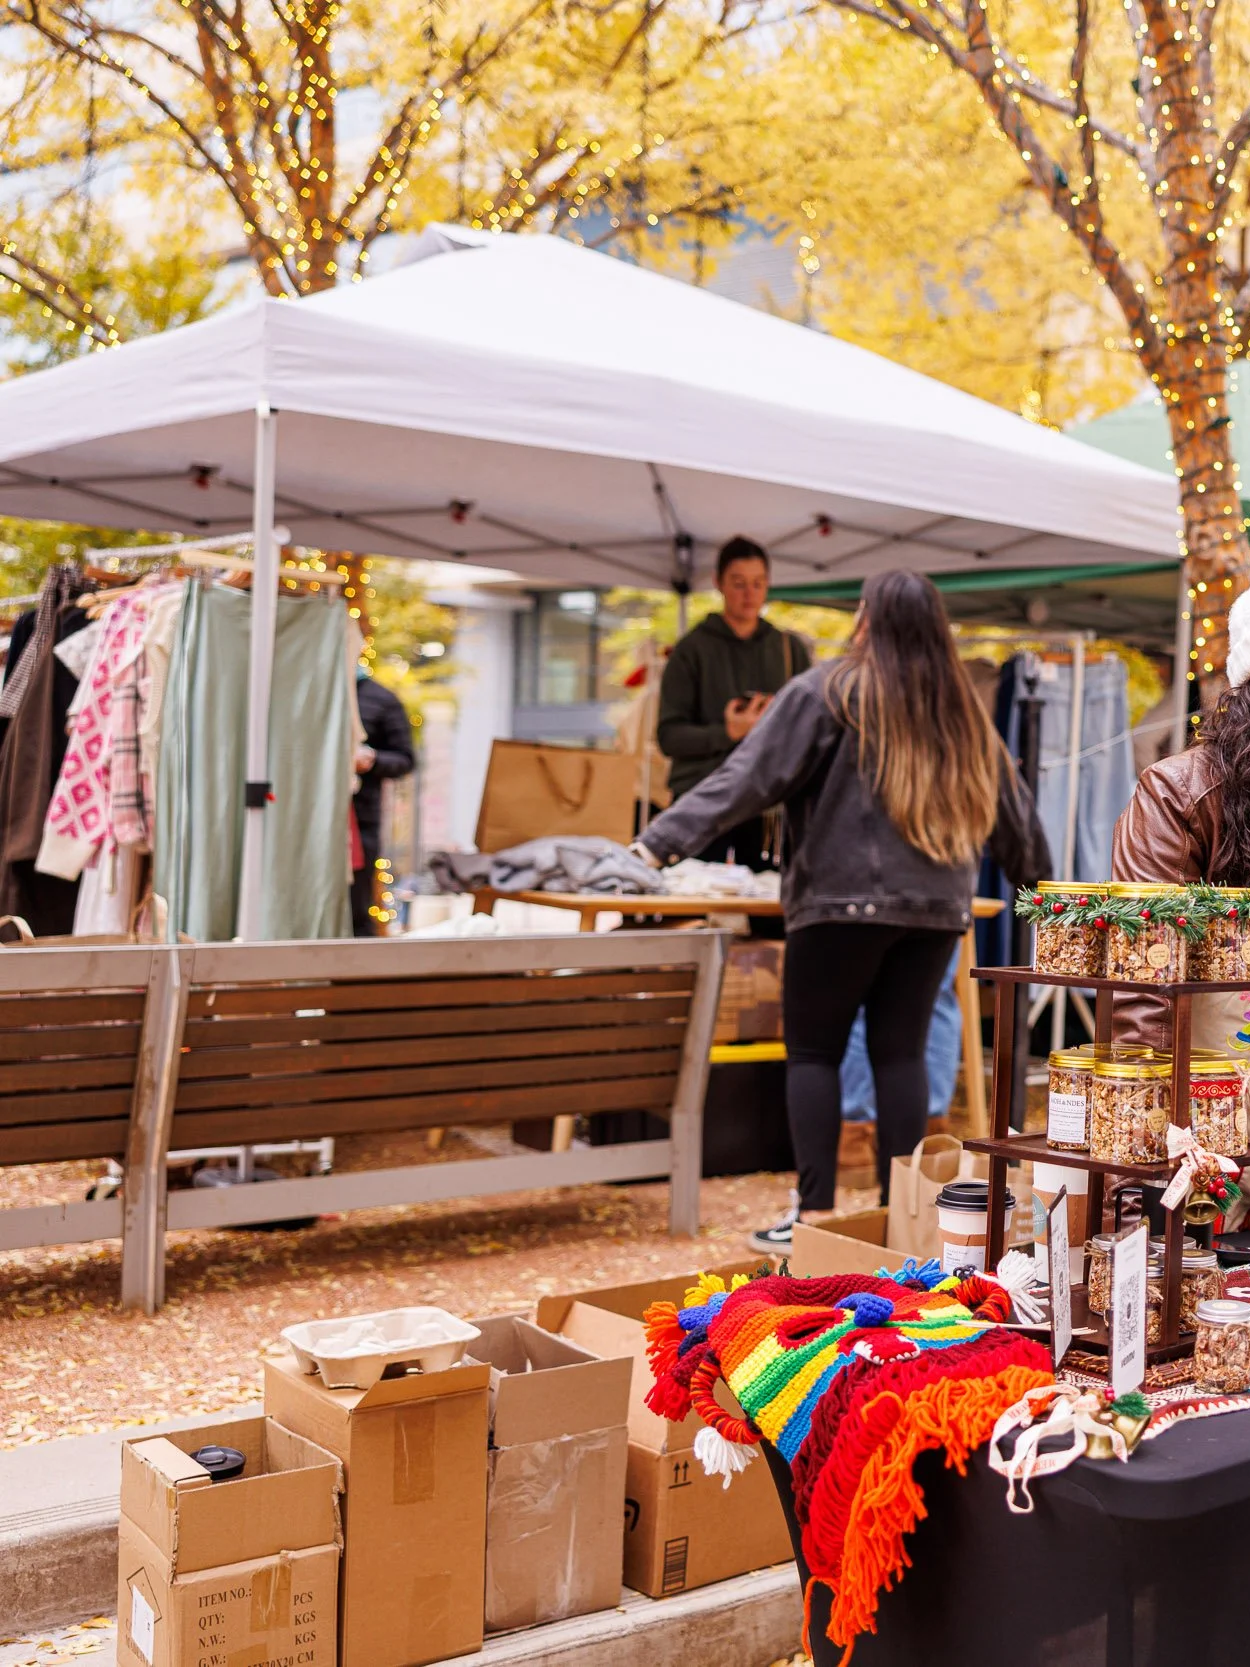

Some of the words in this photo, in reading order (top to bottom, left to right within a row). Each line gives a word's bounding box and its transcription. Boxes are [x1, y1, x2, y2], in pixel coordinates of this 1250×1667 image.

[198, 1591, 227, 1608] ITEM
[229, 1587, 252, 1601] NO.:
[198, 1612, 225, 1630] QTY:
[293, 1591, 313, 1606] PCS
[198, 1634, 226, 1649] N.W.:
[294, 1610, 316, 1626] KGS
[295, 1630, 317, 1645] KGS
[297, 1650, 314, 1664] CM
